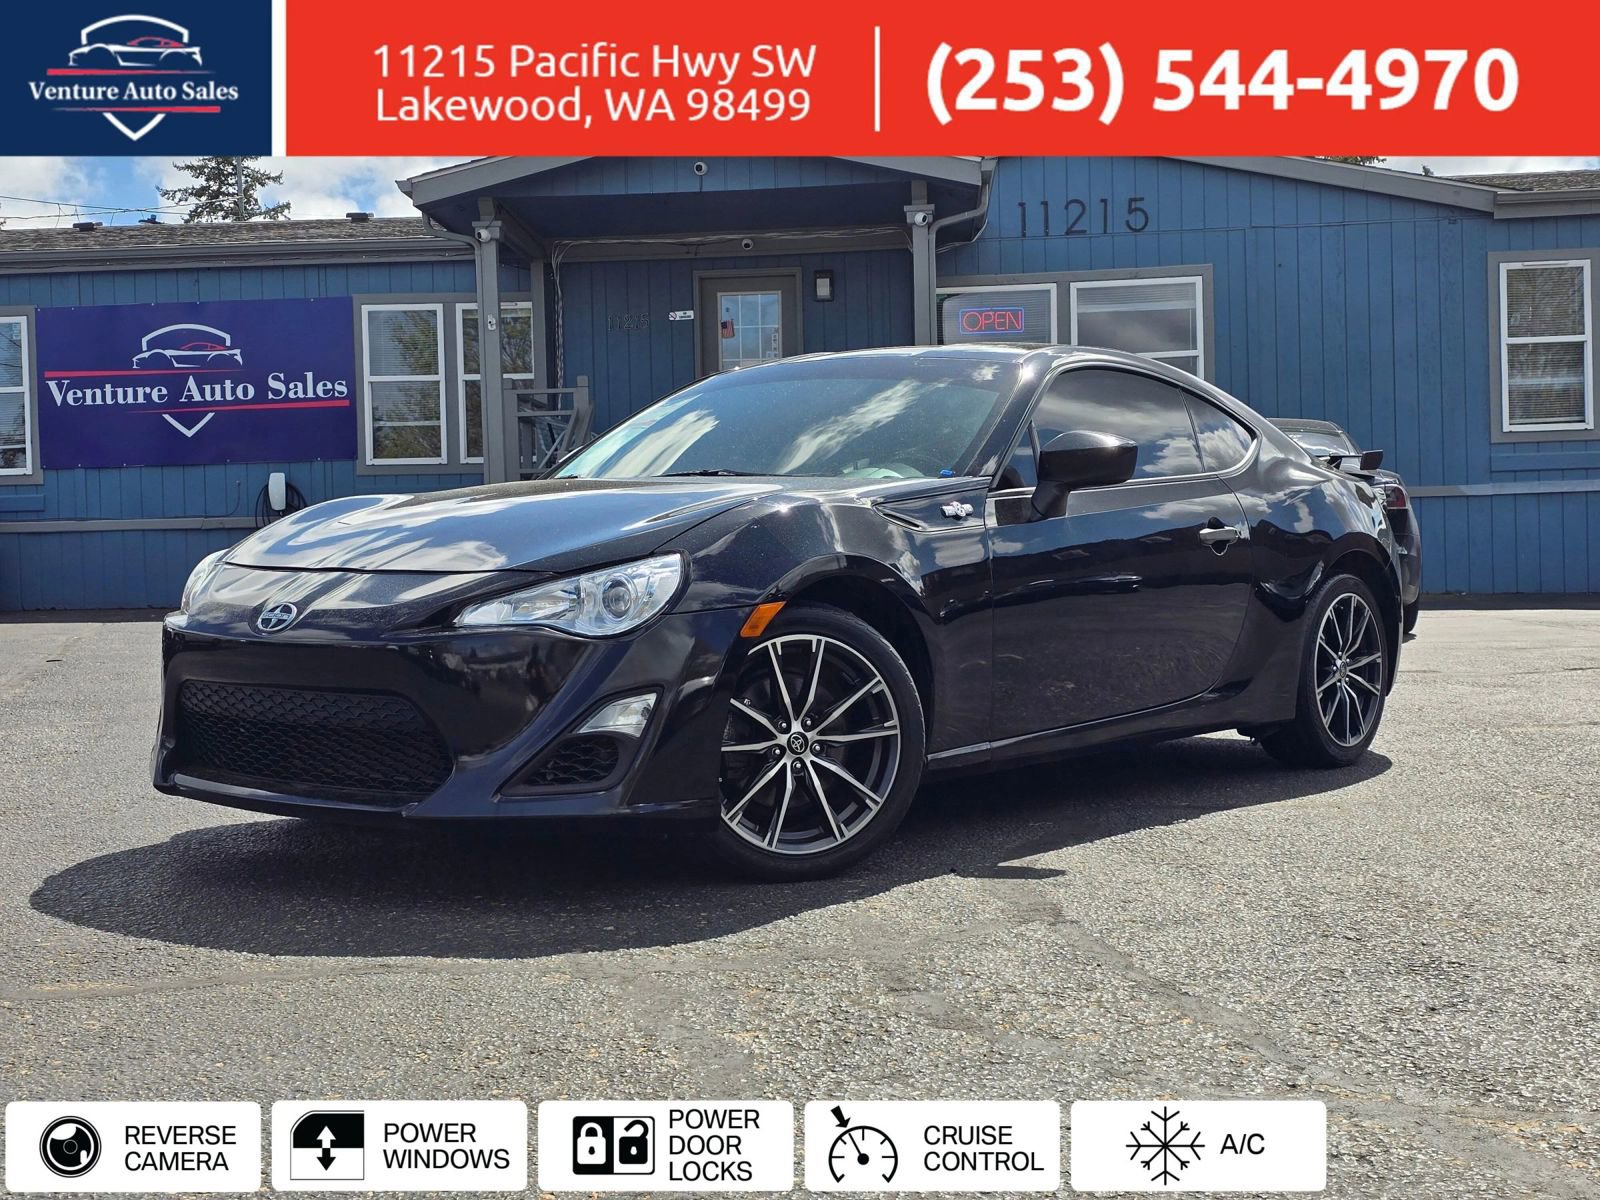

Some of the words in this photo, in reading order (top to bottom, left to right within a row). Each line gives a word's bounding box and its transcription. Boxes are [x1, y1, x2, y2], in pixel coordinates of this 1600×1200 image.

[1017, 197, 1149, 238] 11215
[962, 311, 1022, 331] OPEN
[45, 379, 168, 407] Venture
[178, 374, 255, 402] Auto
[267, 371, 348, 400] Sales
